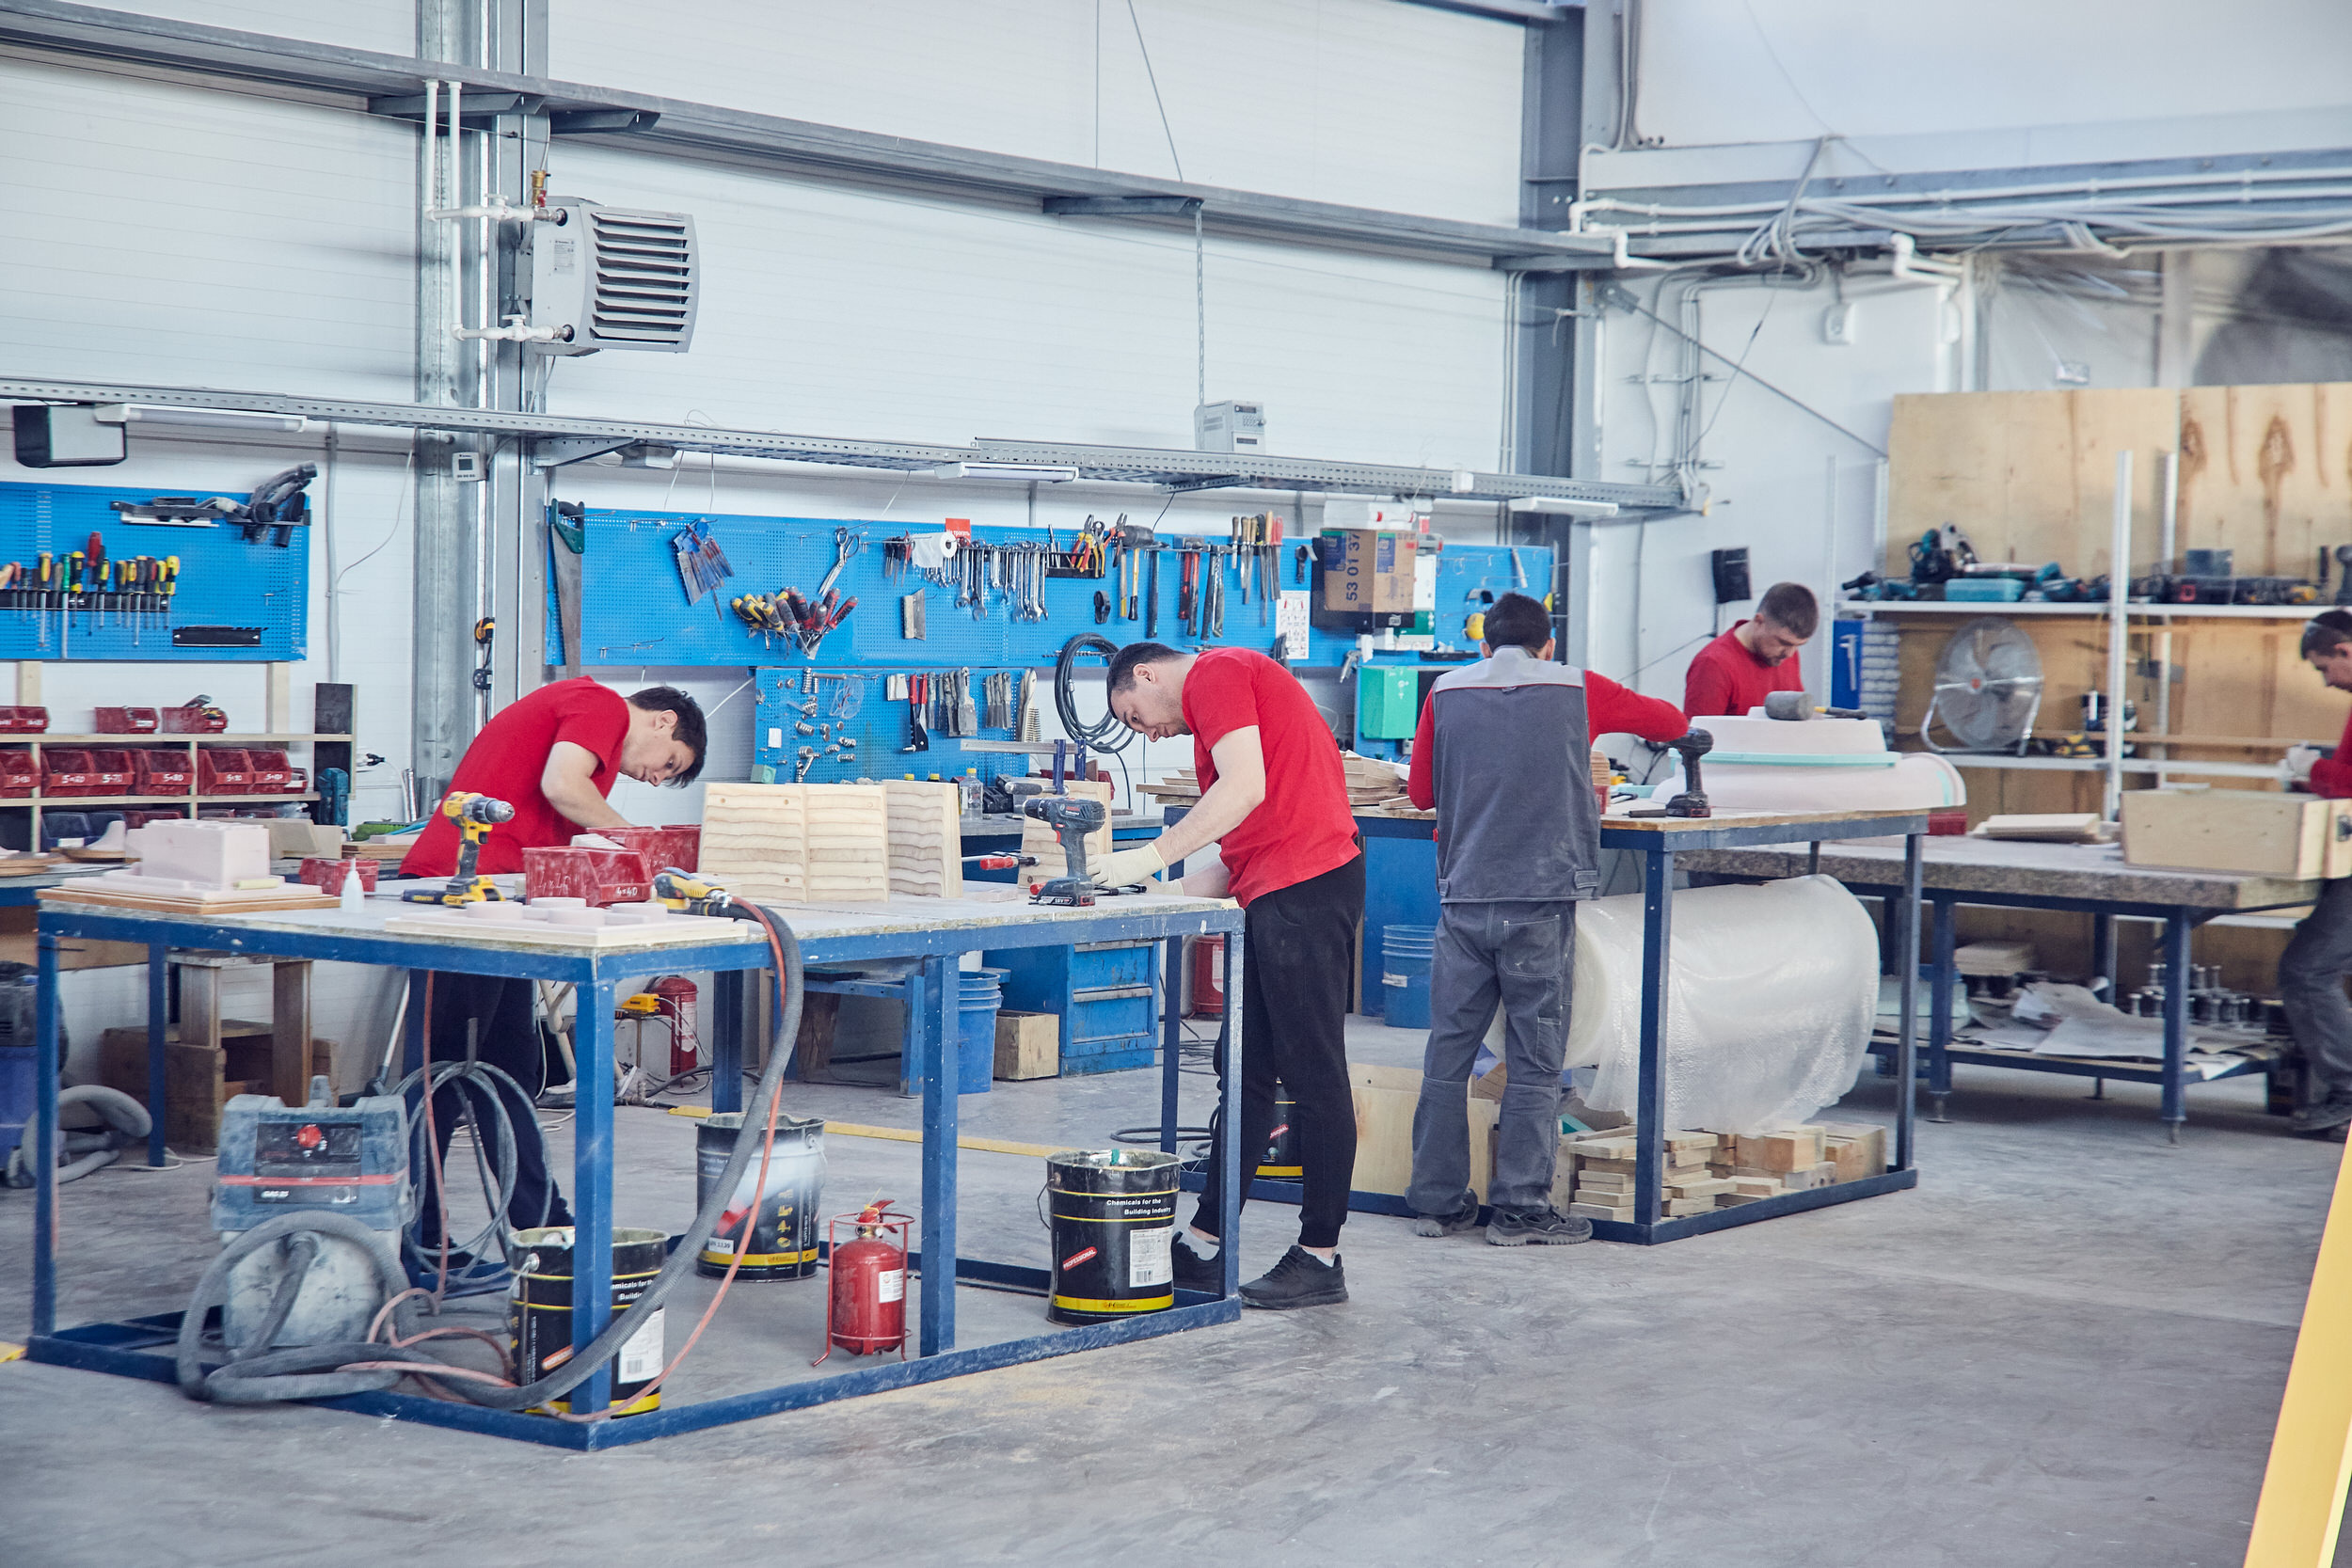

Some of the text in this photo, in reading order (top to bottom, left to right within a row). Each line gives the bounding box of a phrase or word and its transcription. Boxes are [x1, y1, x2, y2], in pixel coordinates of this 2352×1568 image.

[1345, 532, 1360, 602] 53 01 37
